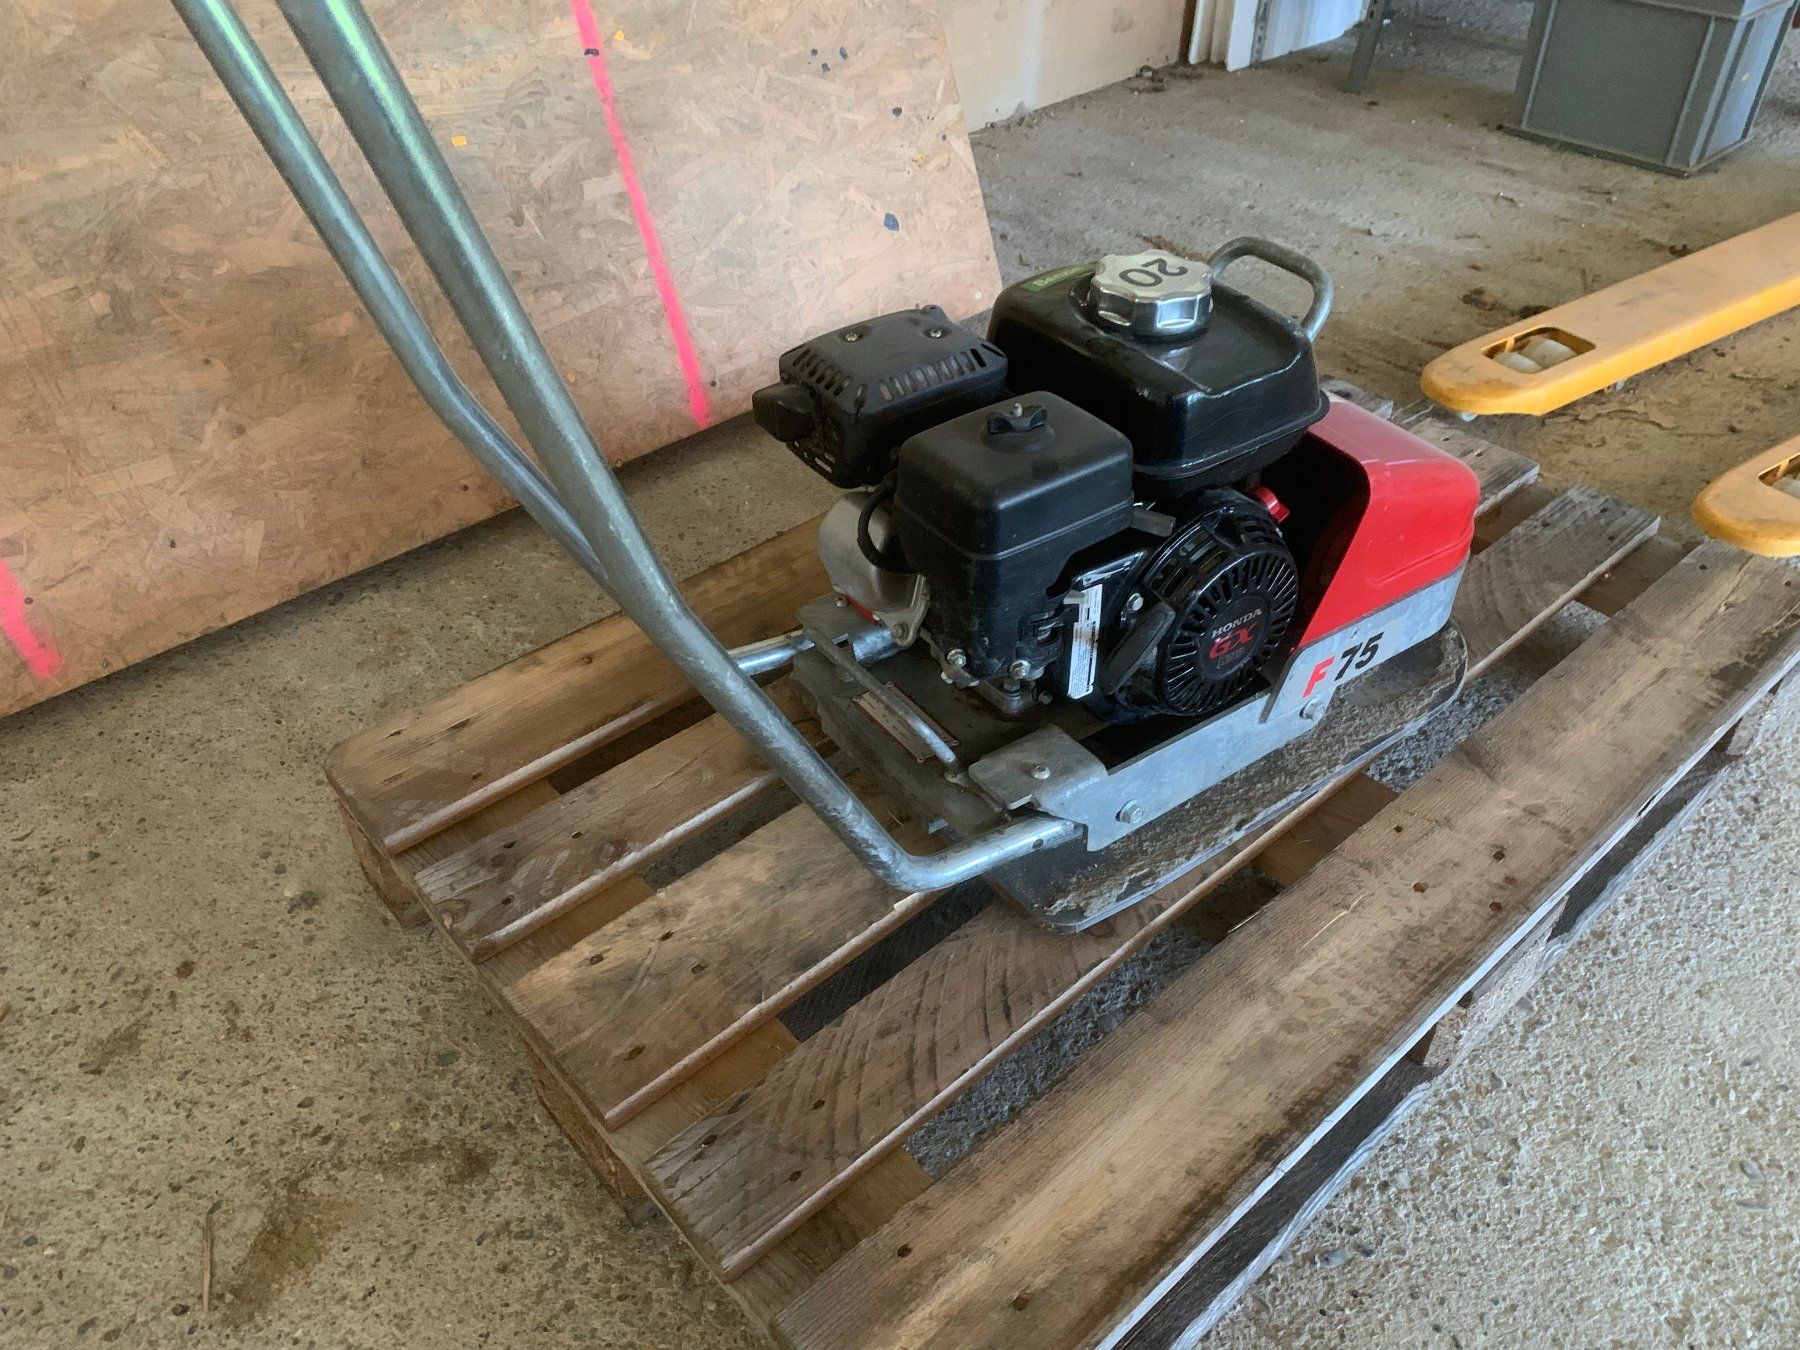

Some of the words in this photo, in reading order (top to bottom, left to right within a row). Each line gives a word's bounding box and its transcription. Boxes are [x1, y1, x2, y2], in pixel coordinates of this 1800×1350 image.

[1118, 257, 1189, 287] 20
[1209, 621, 1259, 660] GX
[1210, 608, 1263, 639] HONDA
[1302, 655, 1336, 699] F
[1333, 631, 1385, 682] 75
